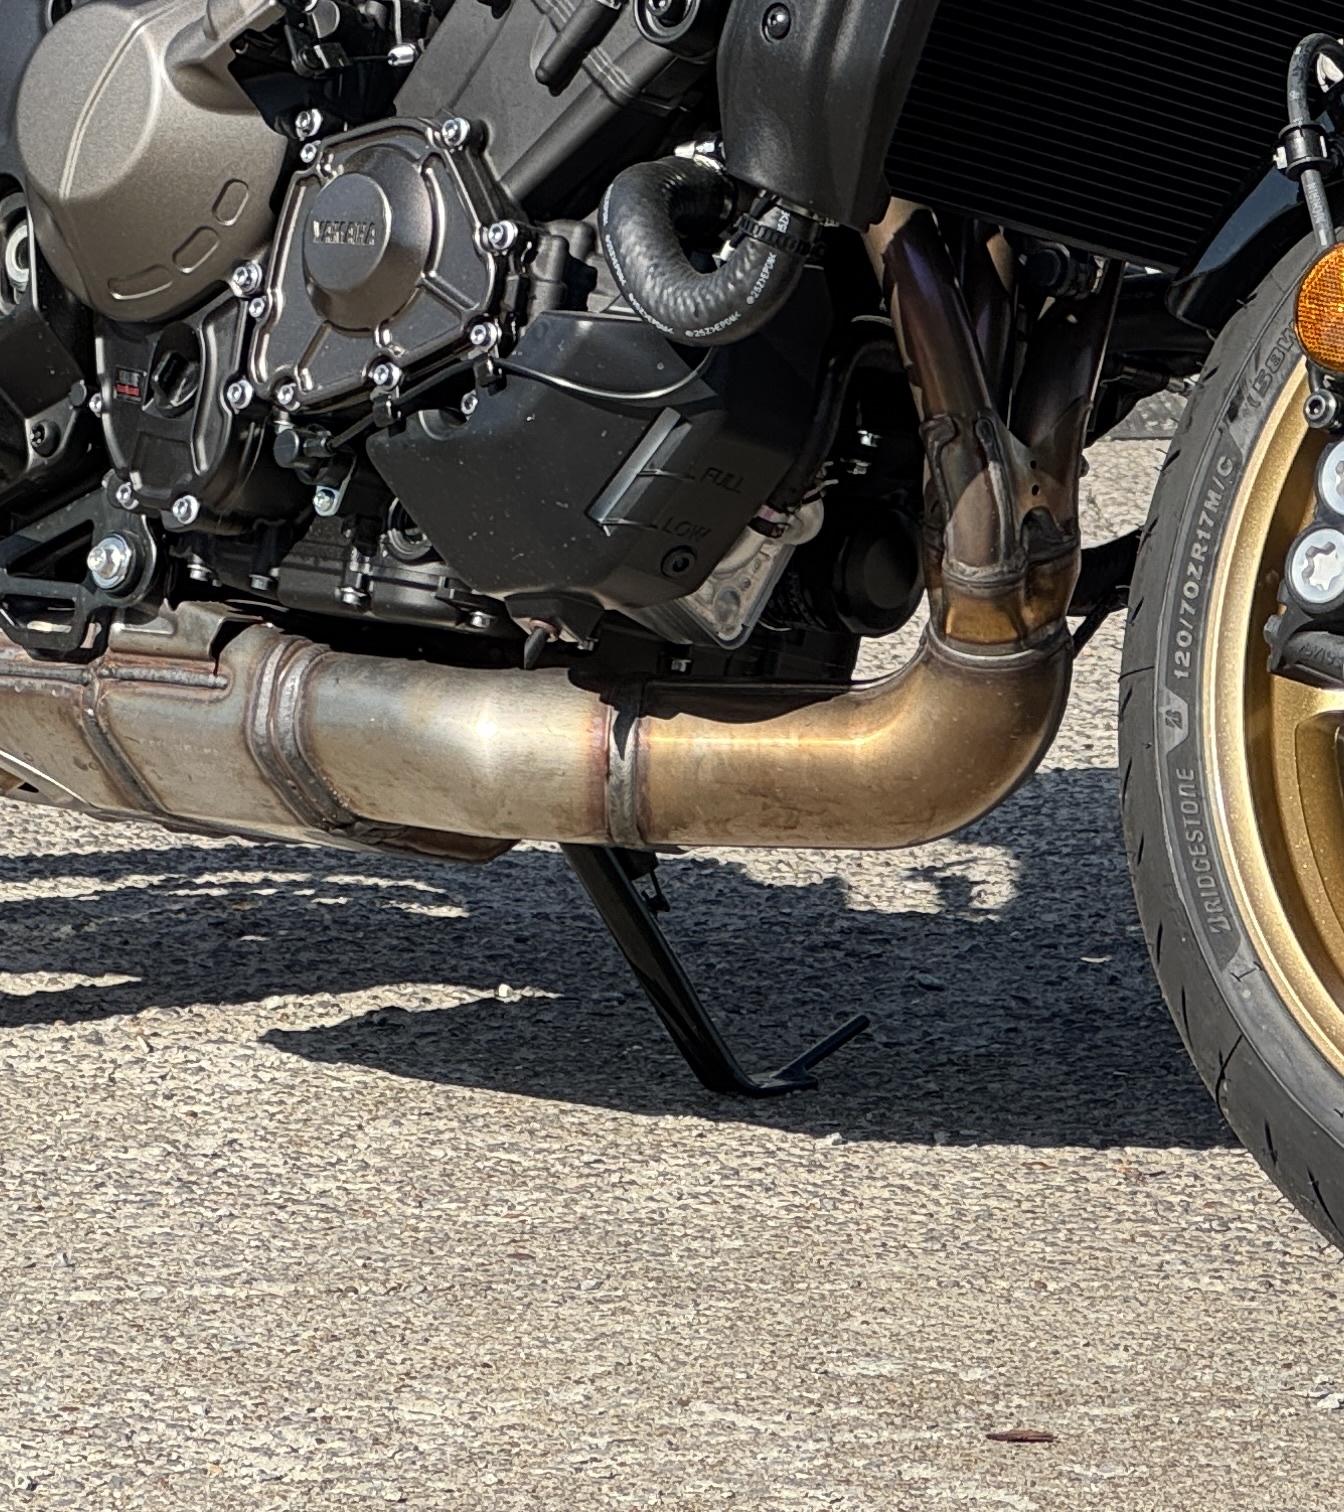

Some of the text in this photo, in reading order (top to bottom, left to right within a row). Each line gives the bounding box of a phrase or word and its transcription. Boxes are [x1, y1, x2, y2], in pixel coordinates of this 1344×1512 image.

[312, 219, 376, 246] YAMAHA
[1173, 455, 1234, 680] 120/70ZR17M/C
[1175, 767, 1232, 934] BRIDGESTONE
